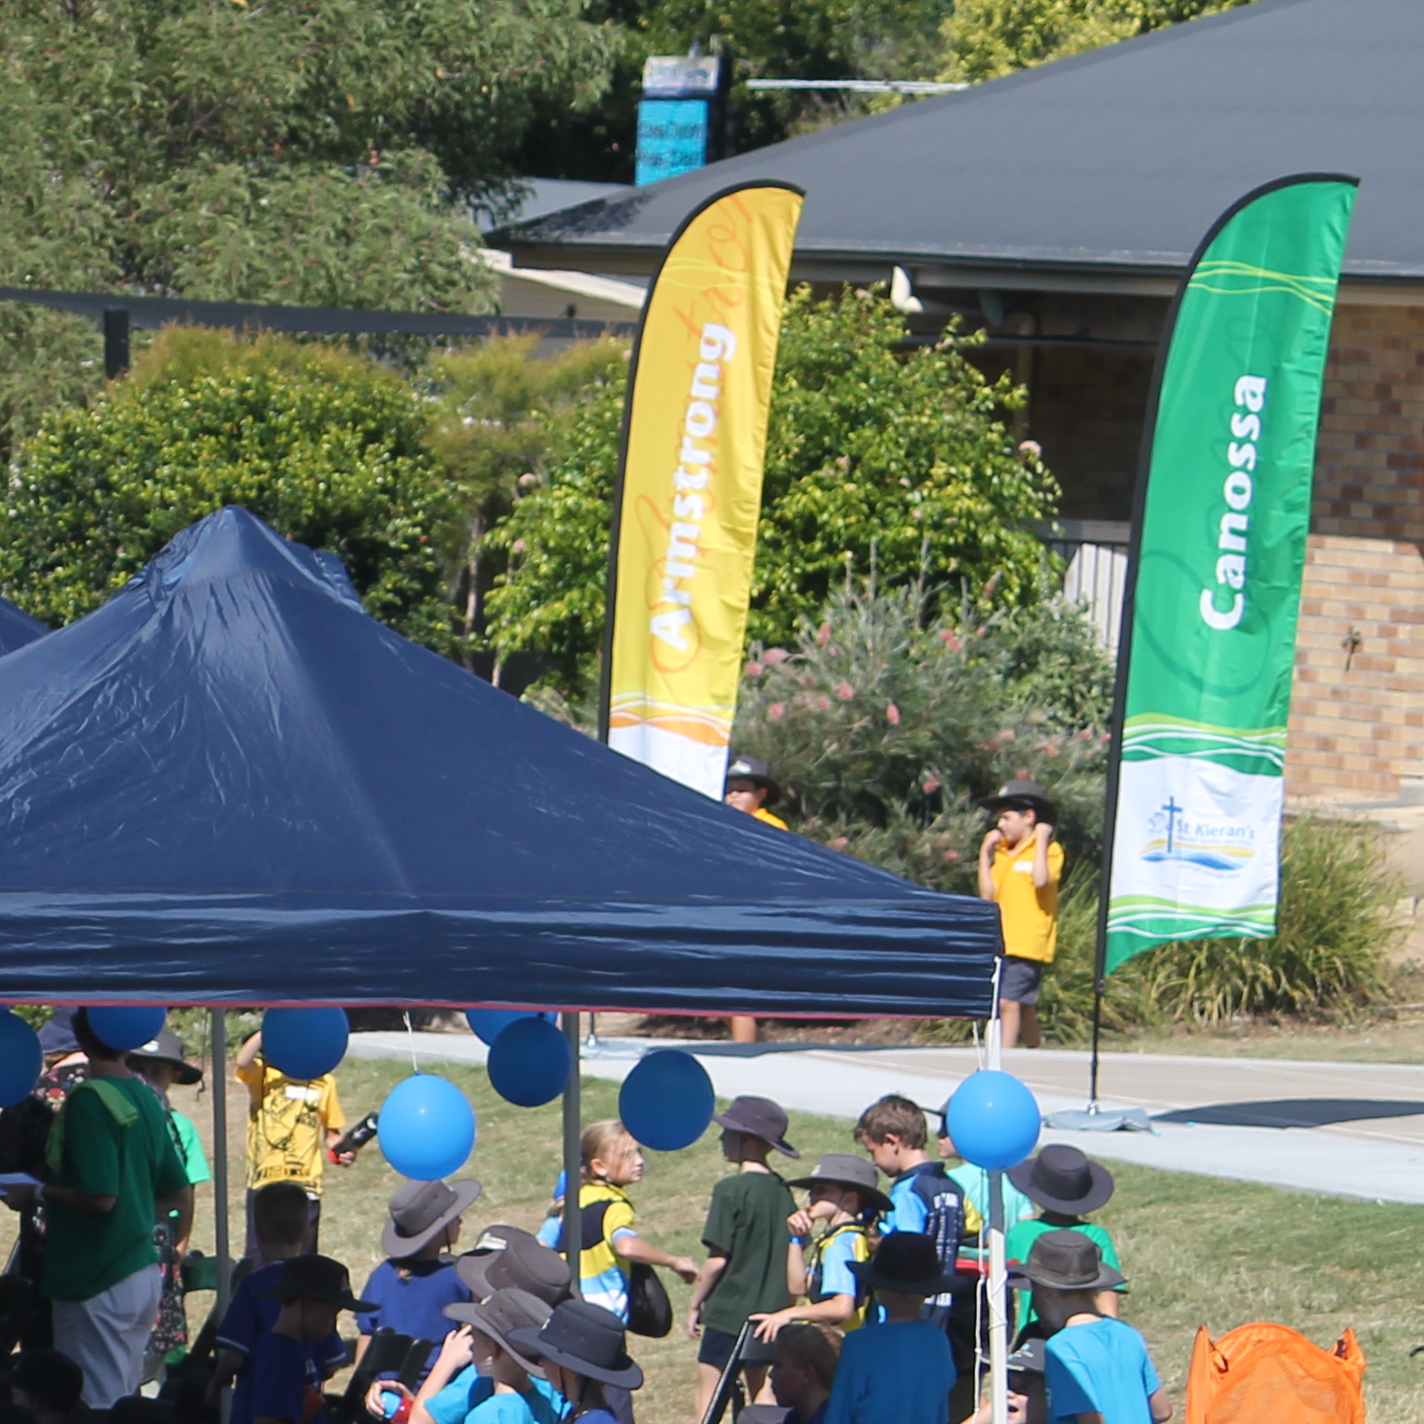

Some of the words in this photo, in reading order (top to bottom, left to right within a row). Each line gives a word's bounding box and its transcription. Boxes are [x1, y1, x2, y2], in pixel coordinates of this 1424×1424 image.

[649, 321, 736, 652] Armstrong
[1198, 374, 1268, 631] Canossa
[1195, 821, 1256, 839] Kieran's
